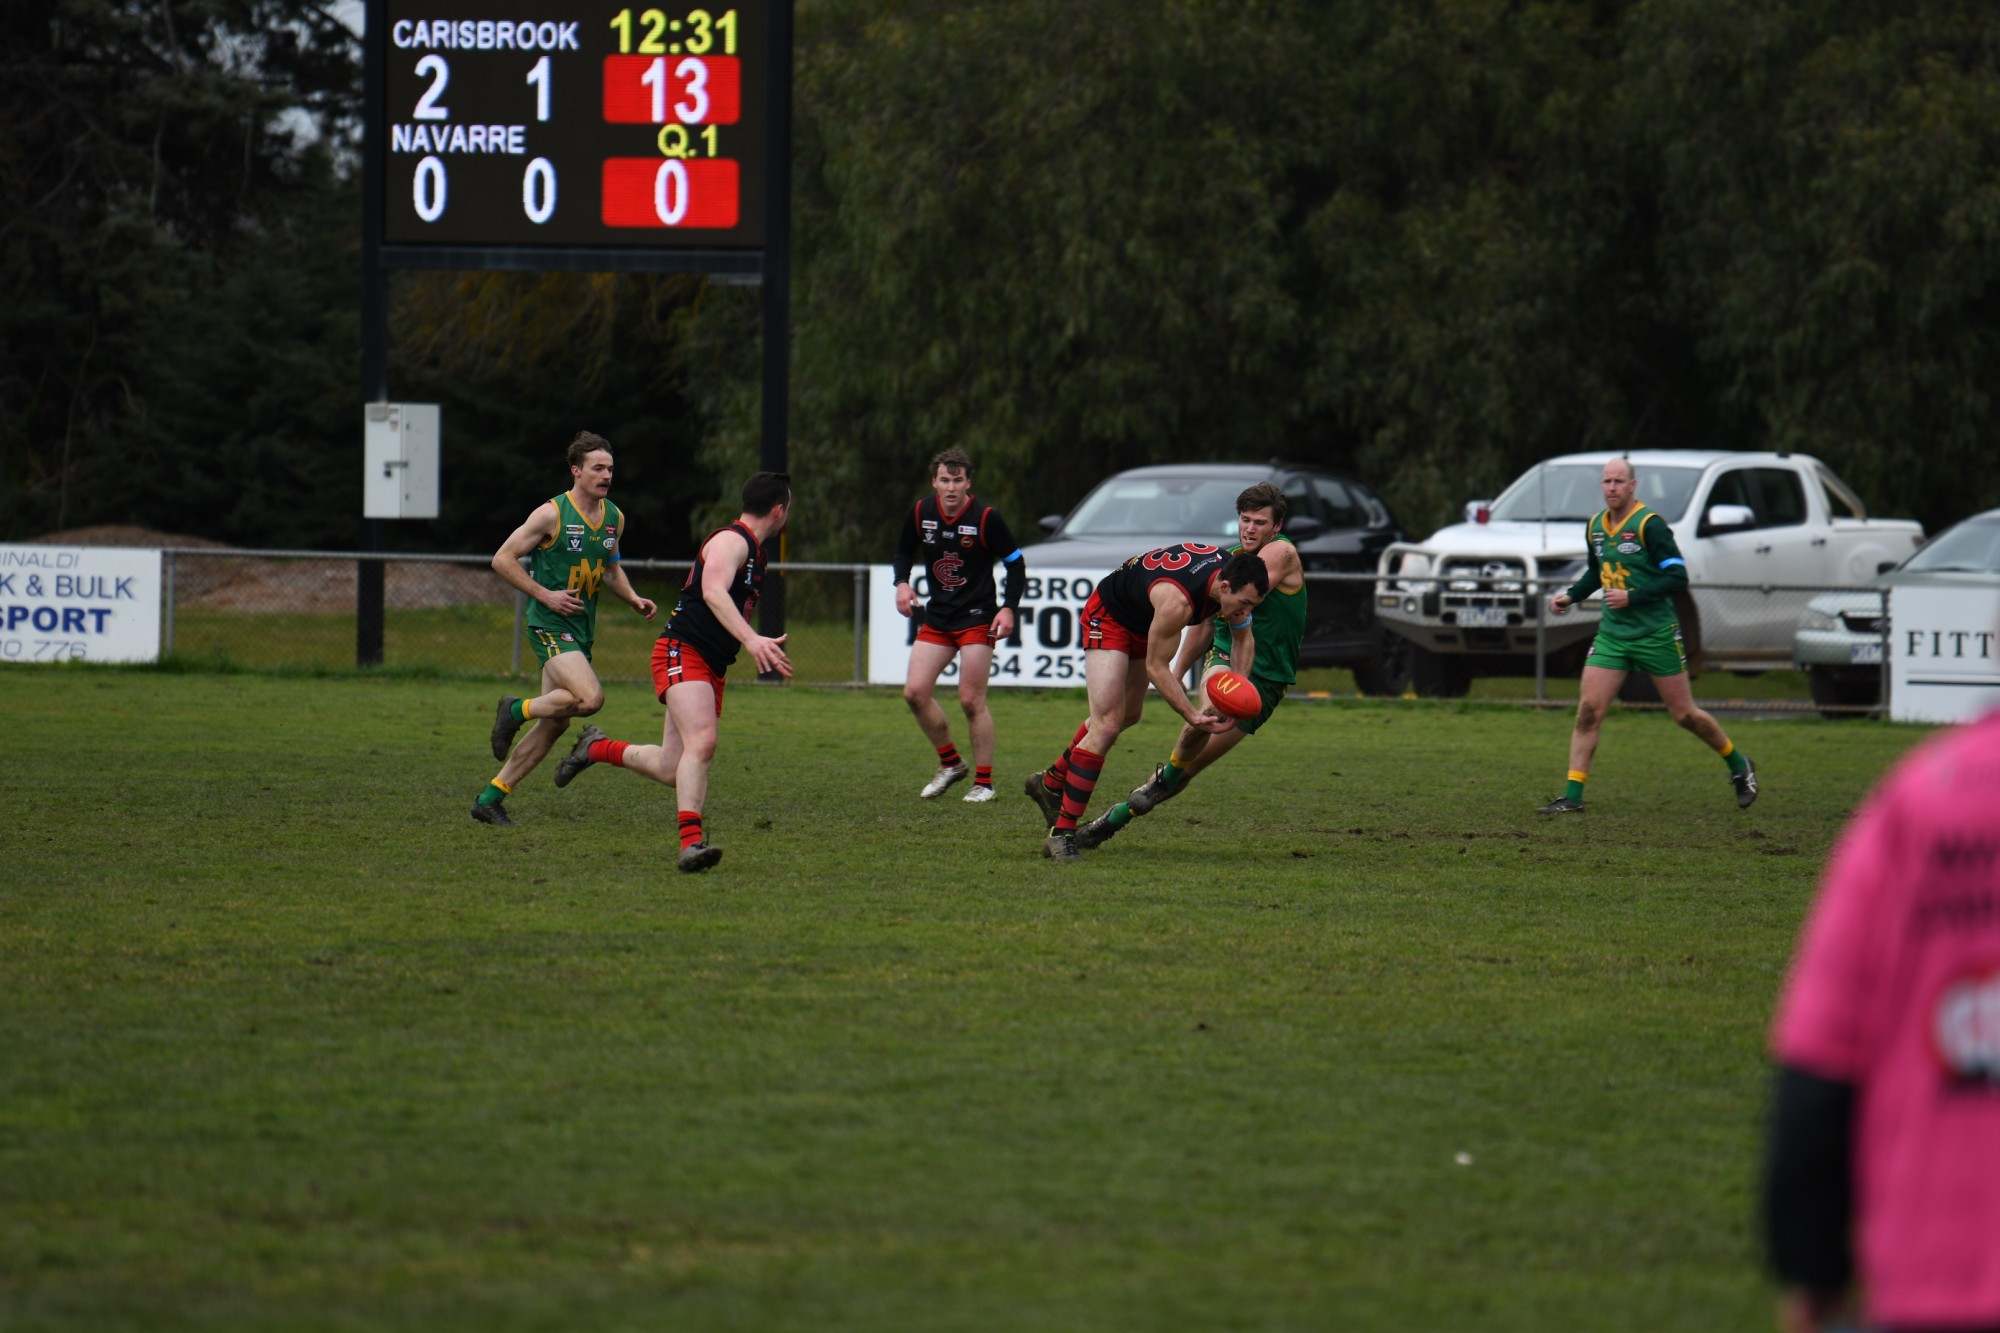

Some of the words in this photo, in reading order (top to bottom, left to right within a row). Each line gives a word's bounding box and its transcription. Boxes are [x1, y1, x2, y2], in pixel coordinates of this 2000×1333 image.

[393, 19, 579, 50] CARISBROOK
[609, 8, 738, 54] 12:31
[412, 54, 449, 121] 2
[525, 56, 551, 122] 1
[640, 57, 709, 124] 13
[391, 124, 526, 154] NAVARRE
[657, 124, 718, 159] Q.1
[413, 156, 447, 222] 0
[522, 157, 557, 223] 0
[654, 159, 688, 225] 0
[0, 551, 79, 569] INALDI
[25, 574, 44, 597] &
[55, 575, 134, 599] BULK
[0, 605, 112, 634] PORT
